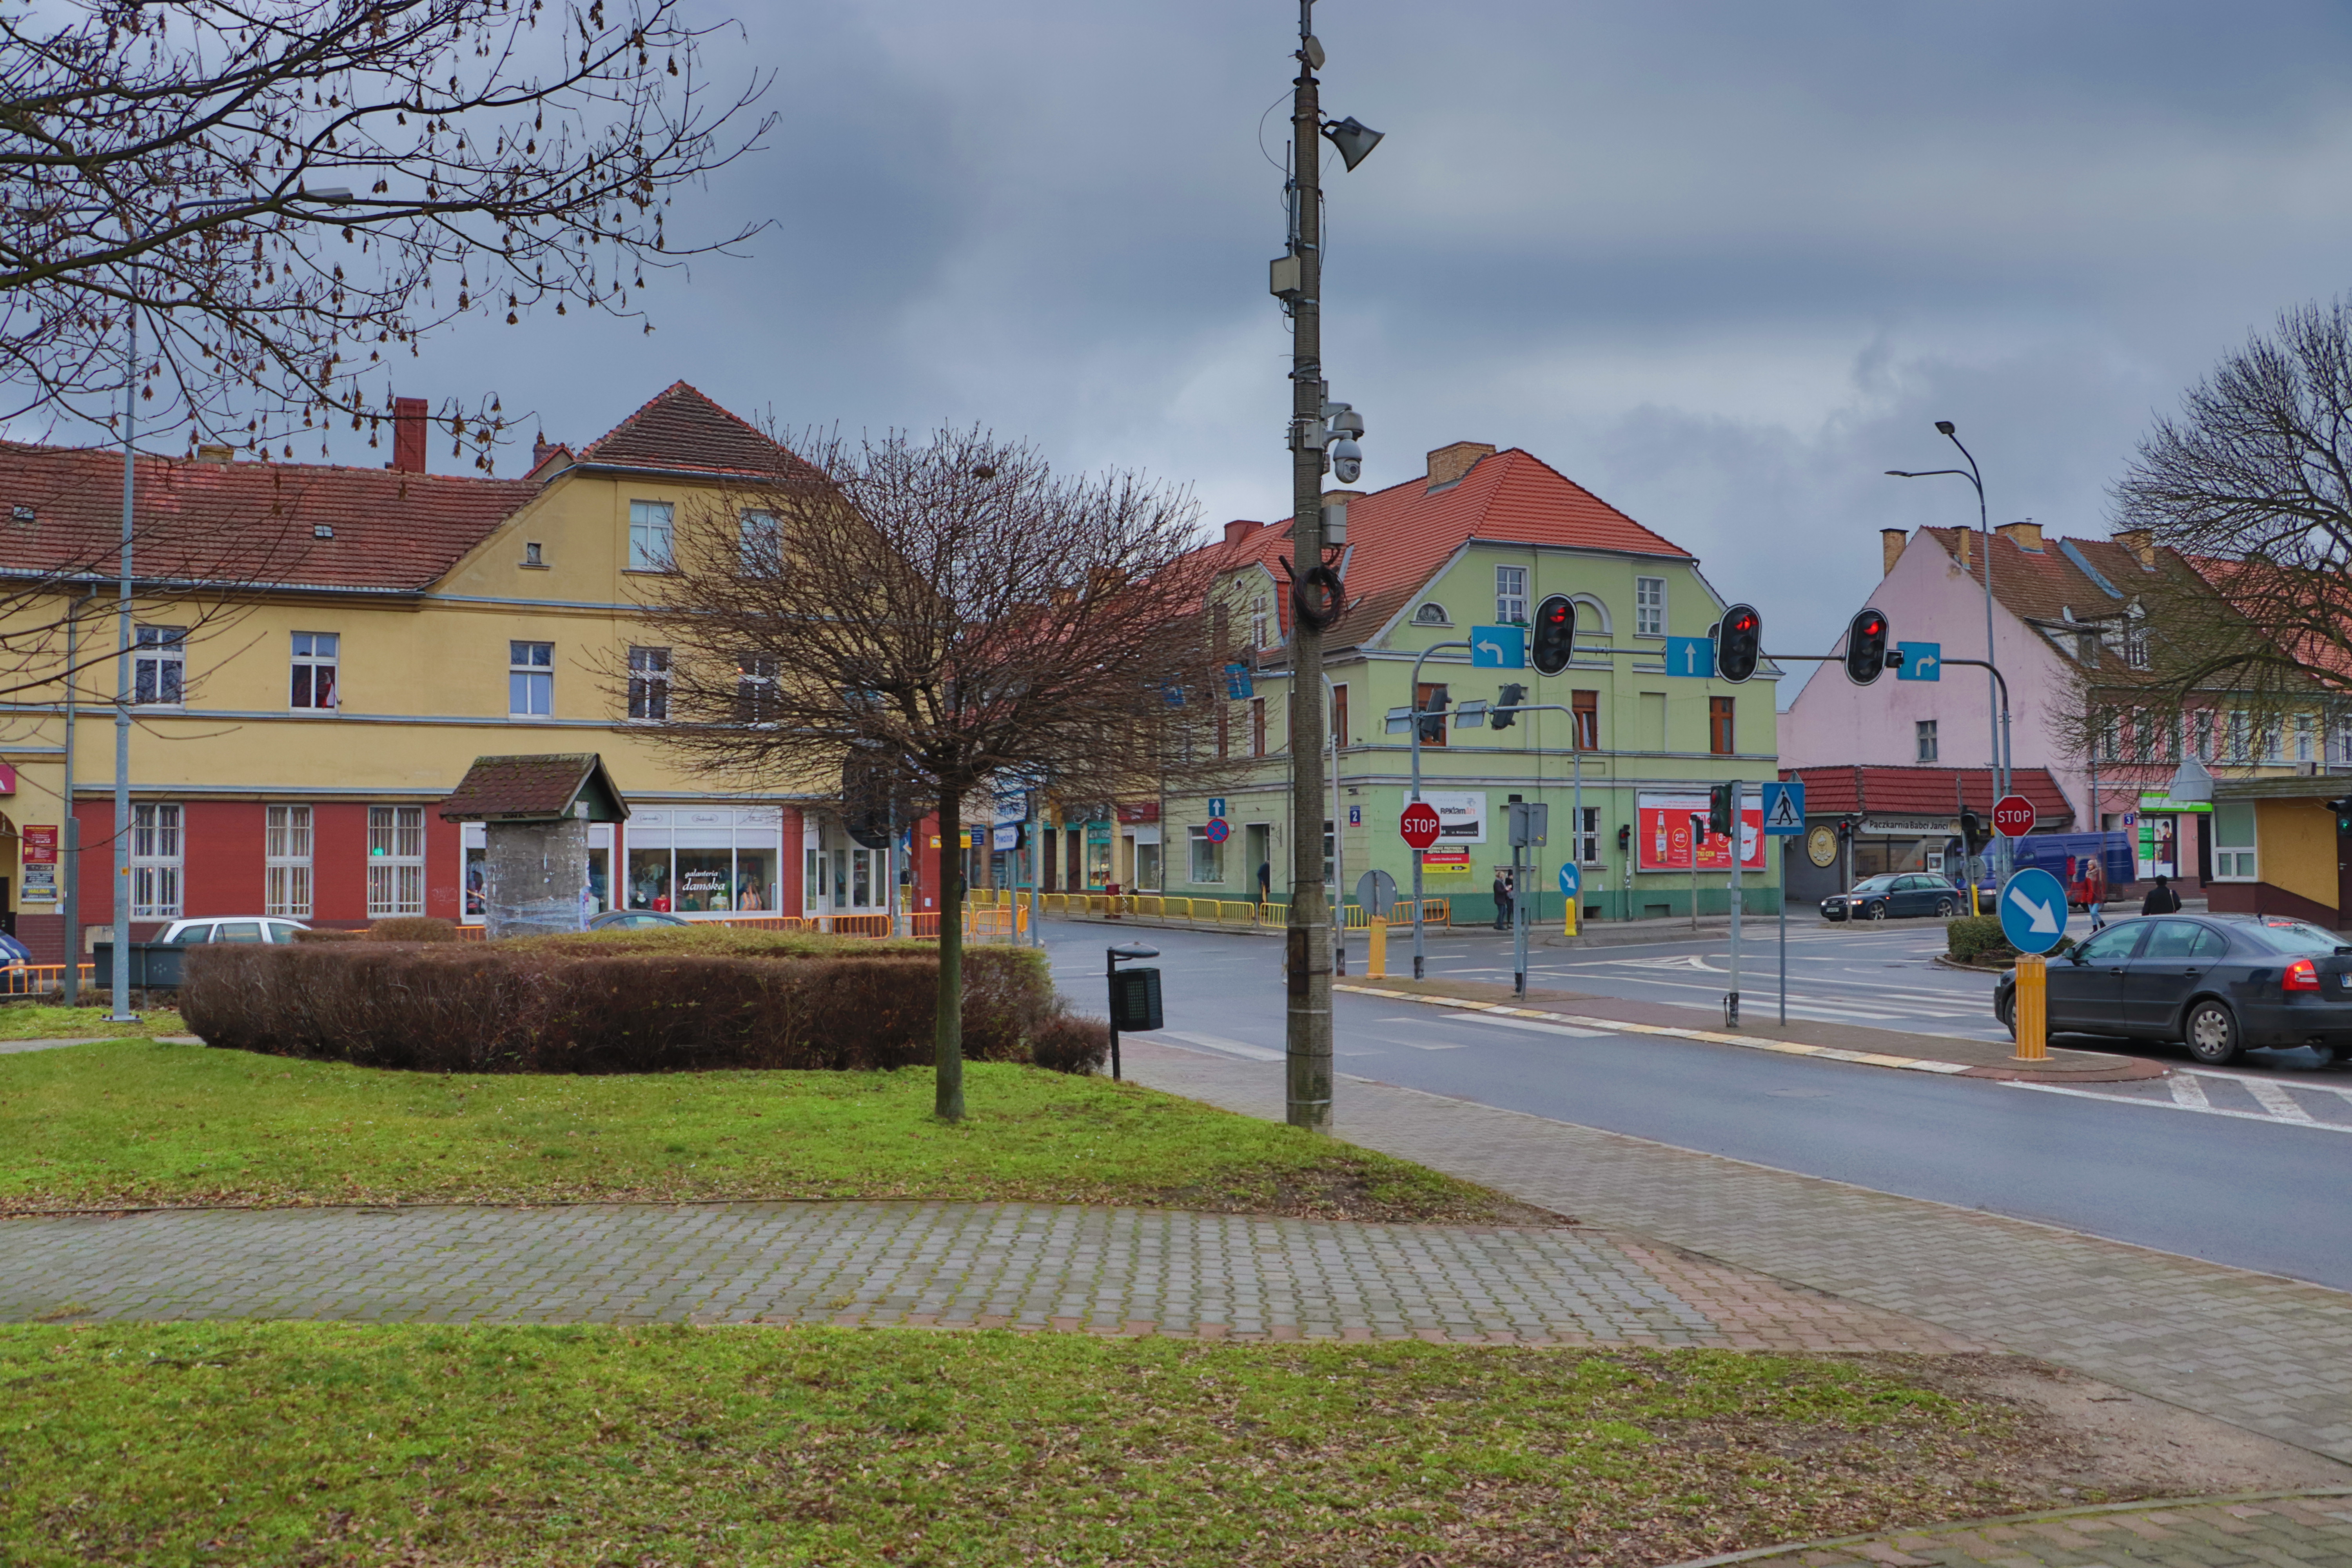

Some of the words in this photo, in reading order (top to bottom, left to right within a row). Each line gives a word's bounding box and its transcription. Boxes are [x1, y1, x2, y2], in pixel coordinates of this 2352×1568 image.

[1352, 811, 1357, 822] 2
[1998, 810, 2031, 823] STOP
[1404, 818, 1437, 833] STOP
[1869, 820, 1909, 830] Pączkarnia
[1910, 820, 1929, 829] Babci
[685, 868, 718, 879] galanteria
[682, 877, 726, 891] damska
